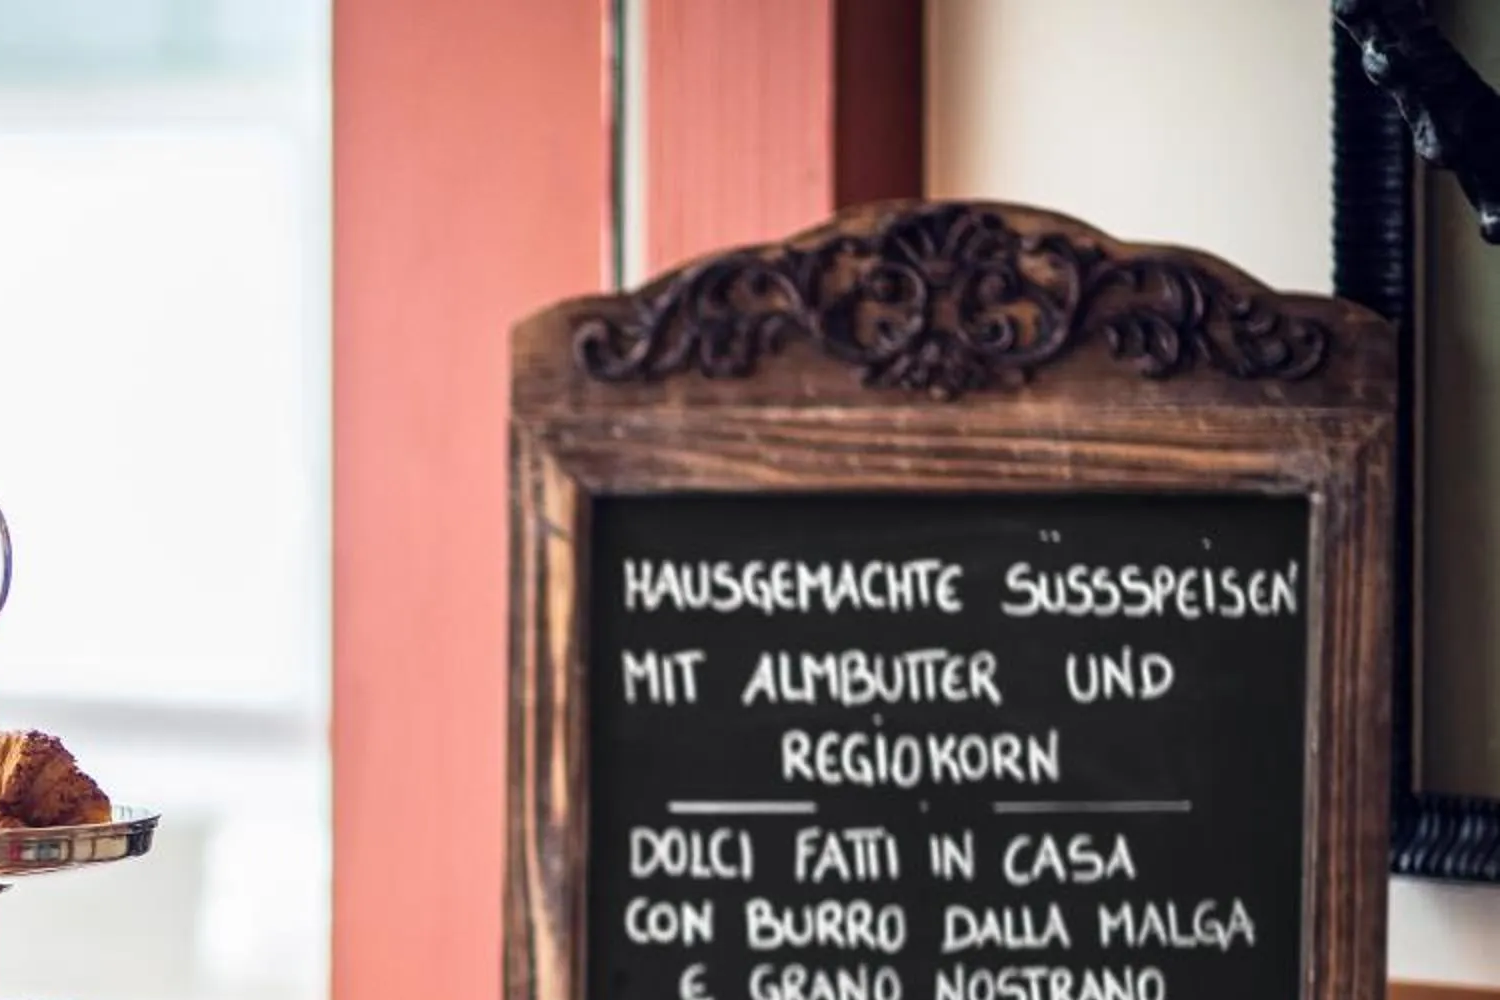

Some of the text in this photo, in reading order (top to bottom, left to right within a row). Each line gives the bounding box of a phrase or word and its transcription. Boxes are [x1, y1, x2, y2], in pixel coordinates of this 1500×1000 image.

[623, 559, 962, 614] HAUSGEMACHTE
[621, 645, 1175, 707] MIT ALMBUTTER UND
[780, 714, 1059, 788] REGIOKORN
[629, 827, 1136, 886] DOLCI FATTI IN CASA
[623, 897, 1255, 953] CON BURRO DALLA MALGA
